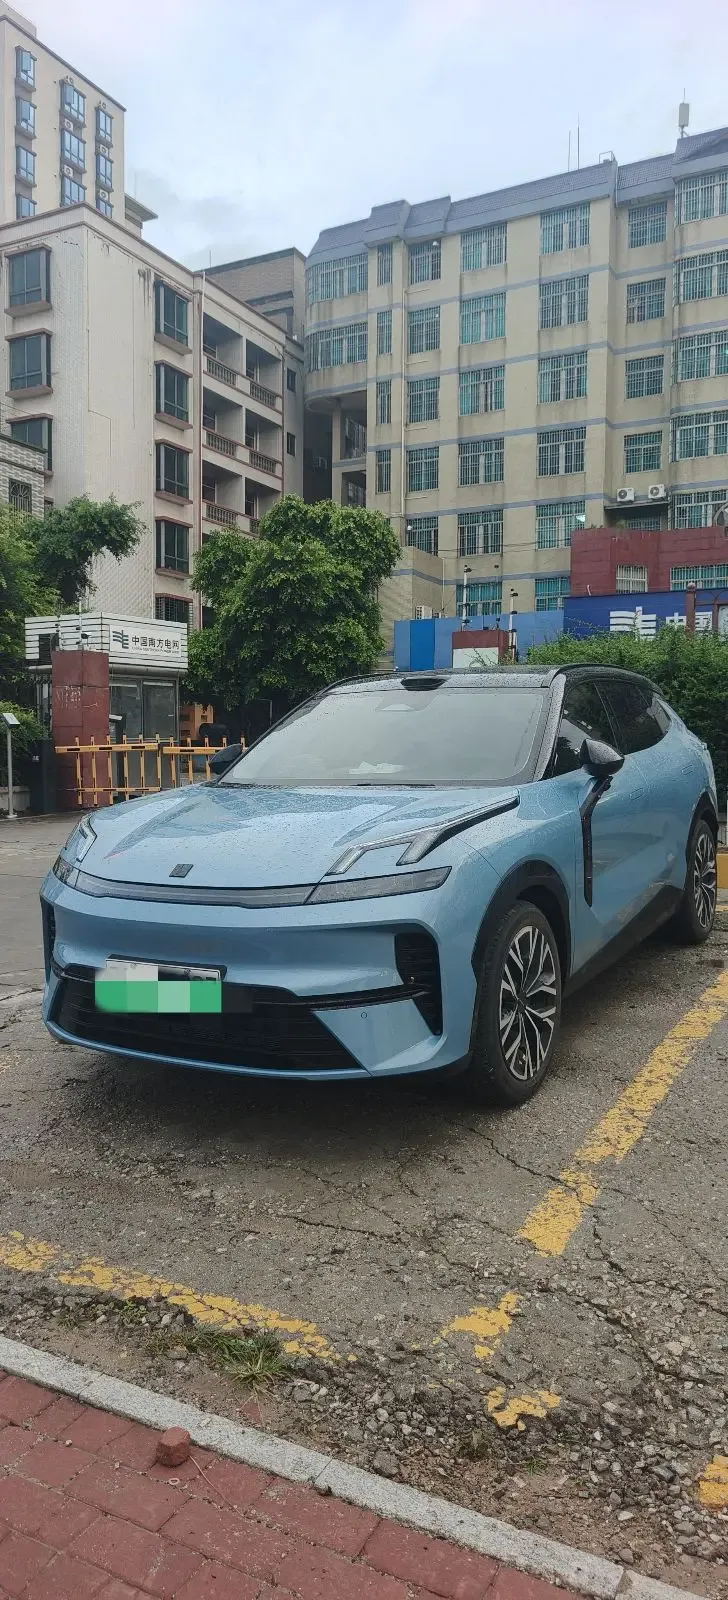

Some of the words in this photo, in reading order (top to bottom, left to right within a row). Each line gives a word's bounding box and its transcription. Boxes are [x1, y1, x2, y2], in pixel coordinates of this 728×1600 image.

[131, 635, 180, 650] 中国南方电网
